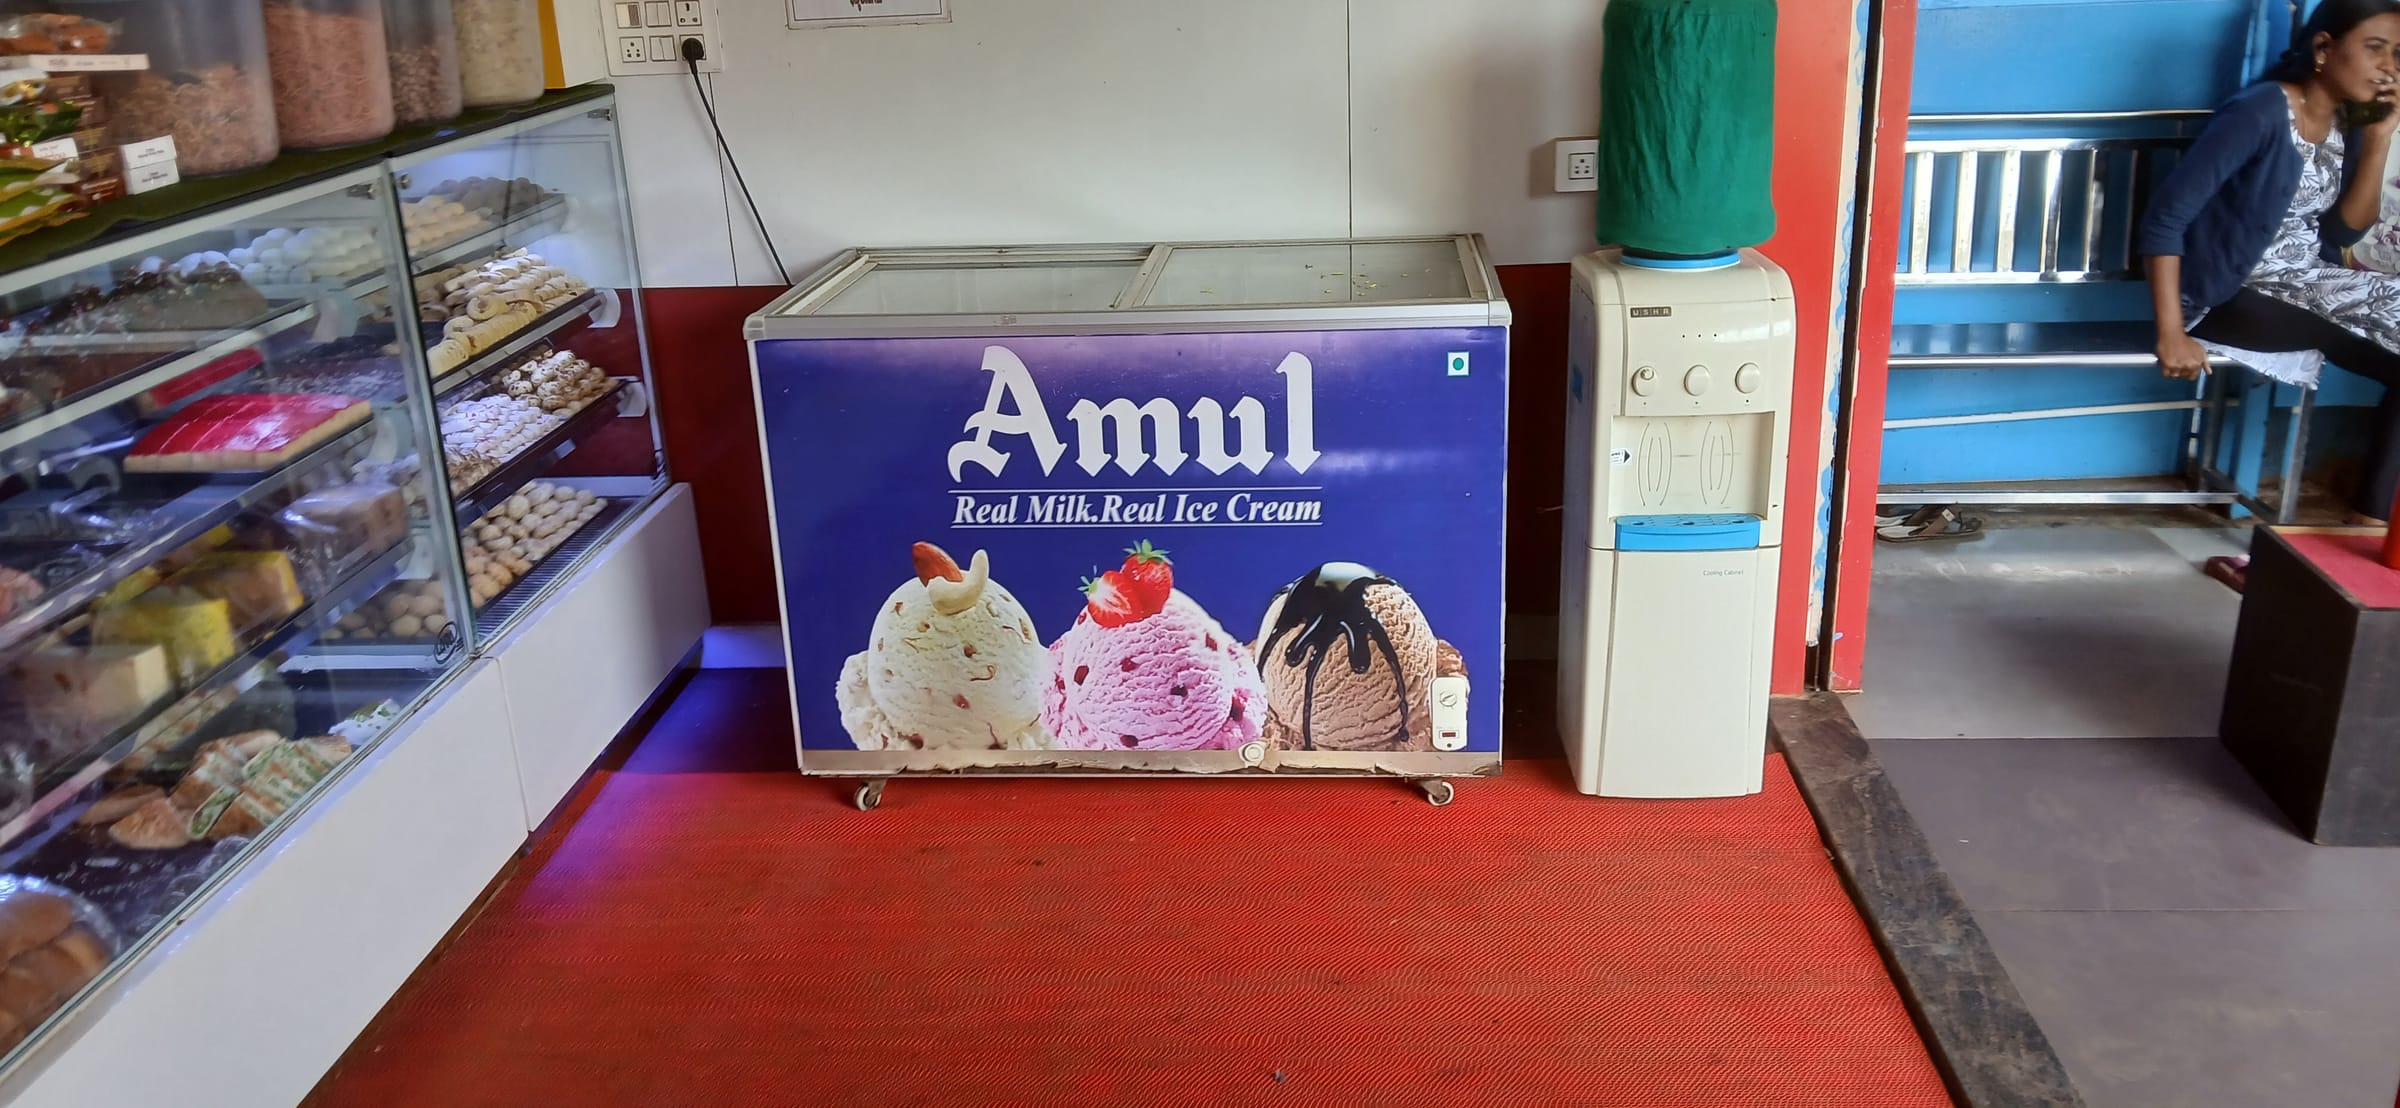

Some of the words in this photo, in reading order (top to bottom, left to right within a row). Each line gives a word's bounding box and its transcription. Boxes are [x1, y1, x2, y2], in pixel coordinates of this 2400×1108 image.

[1632, 308, 1670, 317] USHA
[947, 345, 1322, 483] Amul
[952, 495, 1019, 524] Real
[1171, 494, 1219, 523] Ice
[1226, 493, 1321, 522] Cream
